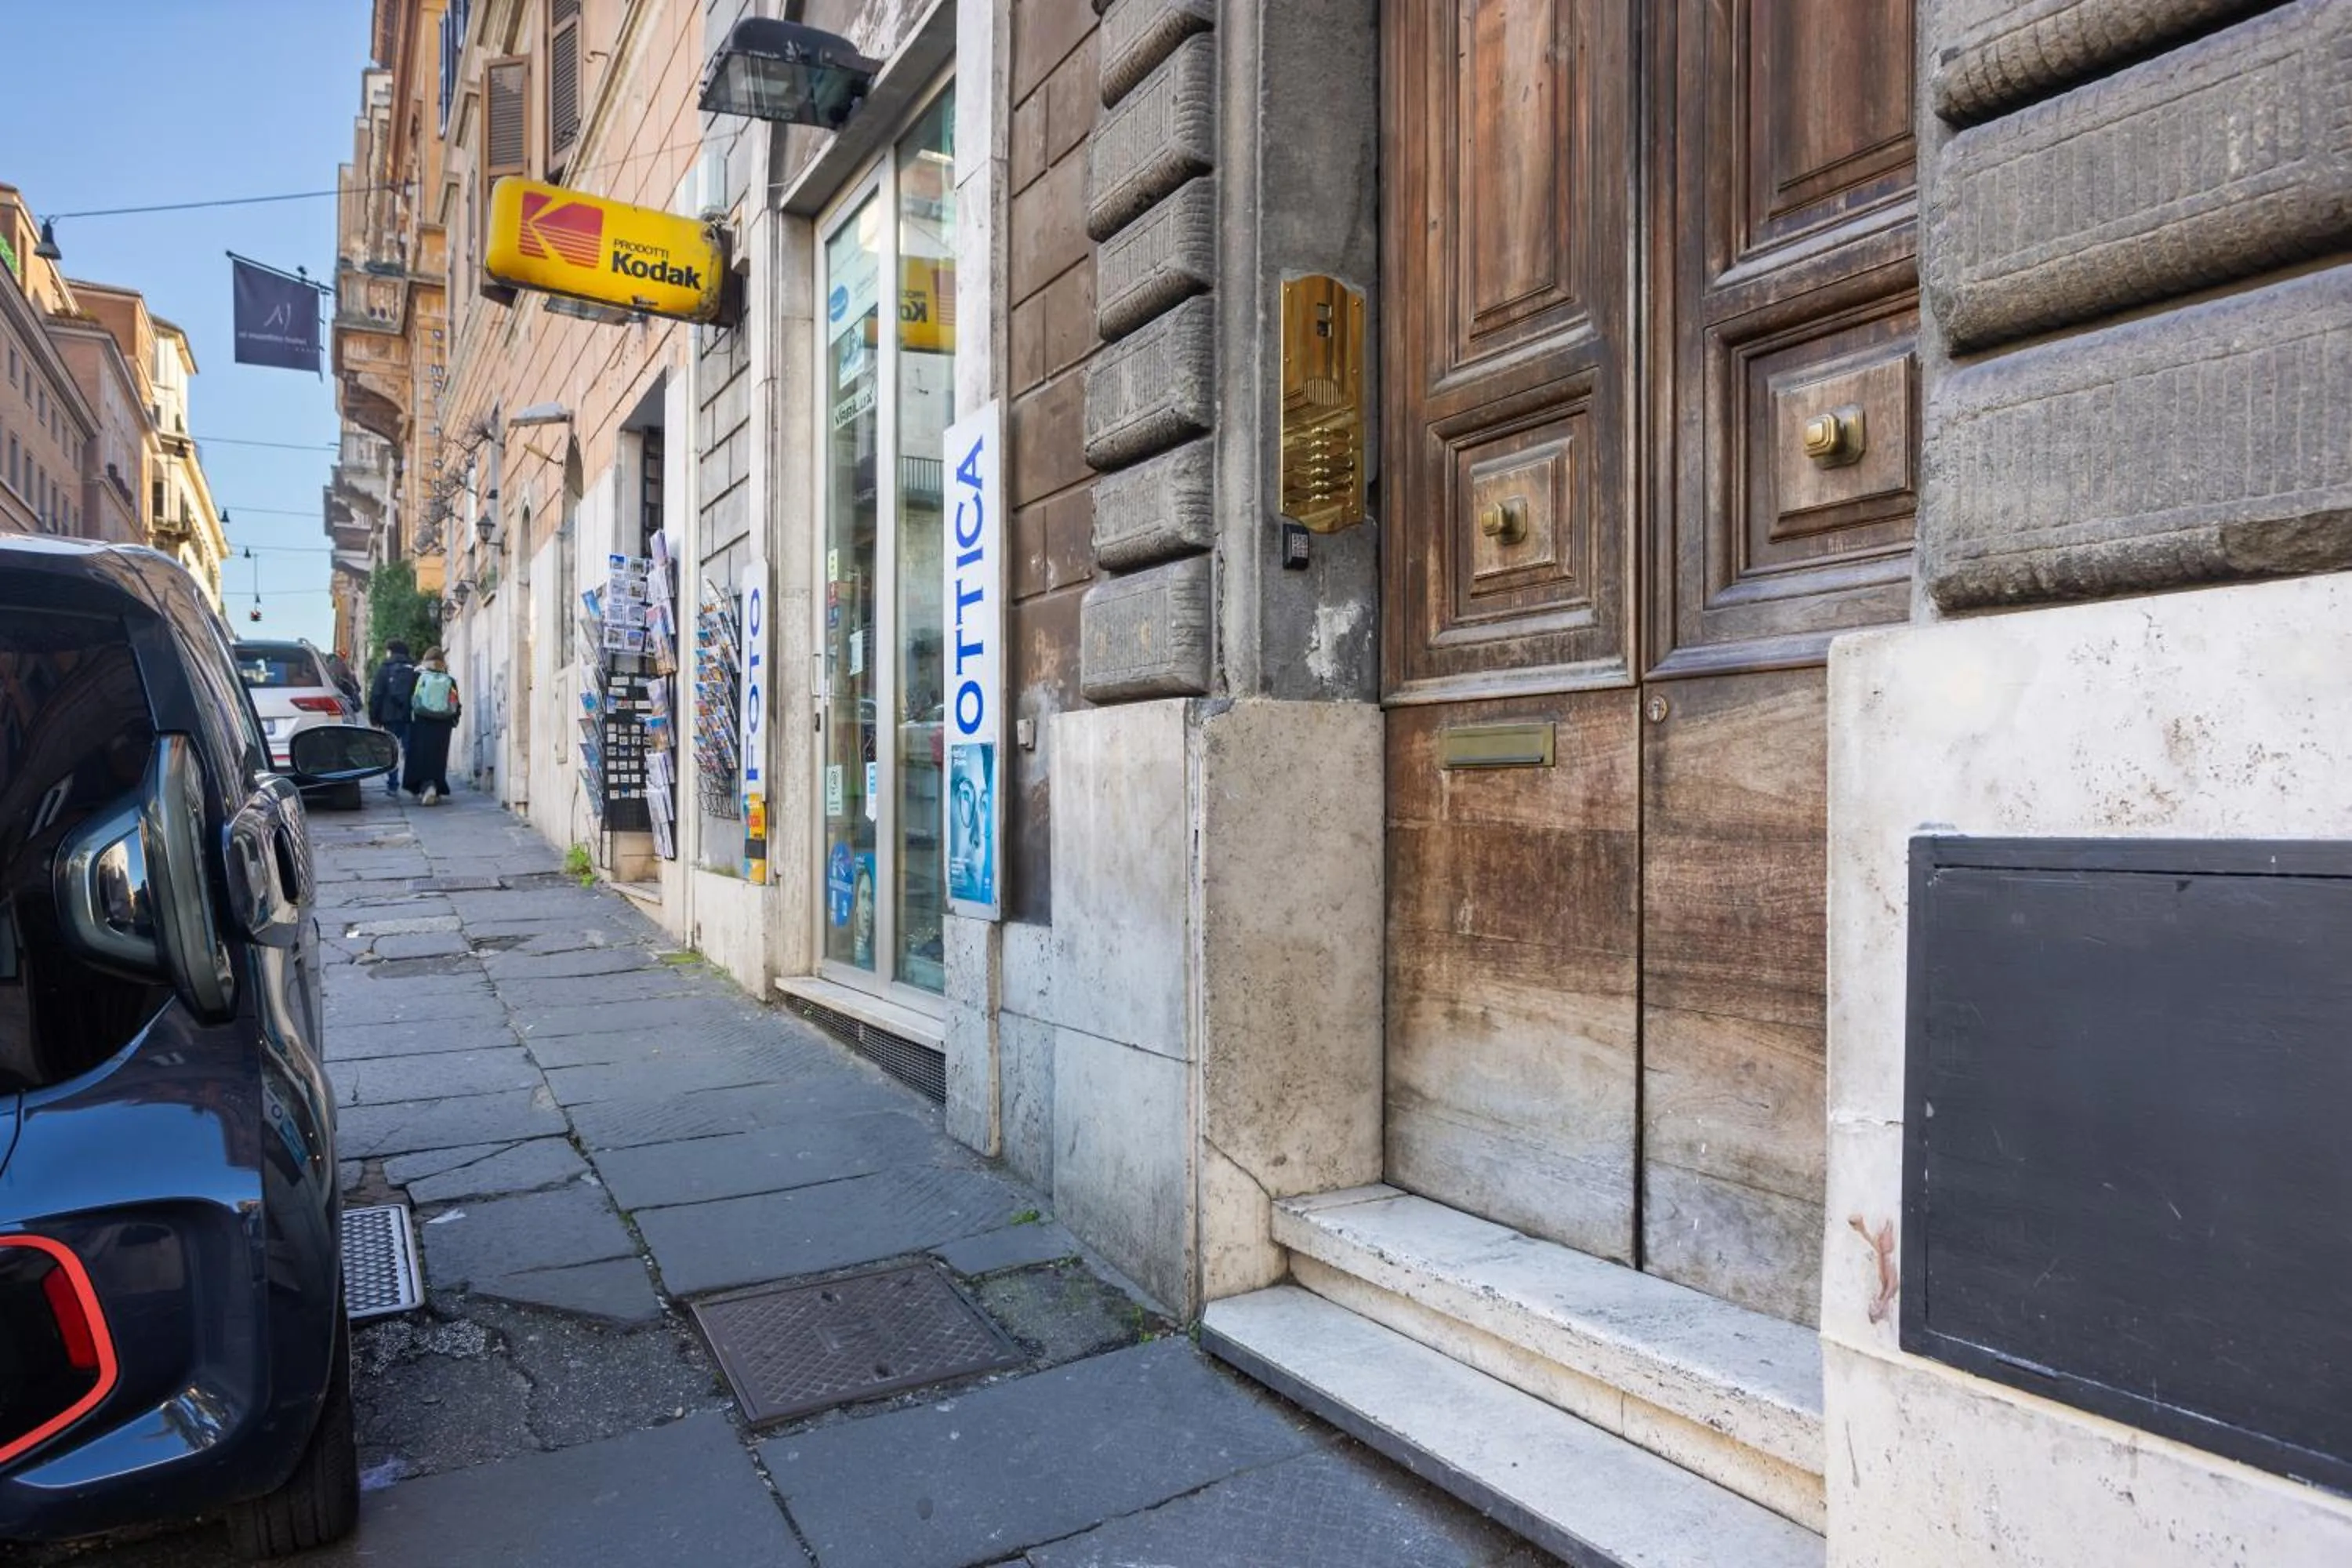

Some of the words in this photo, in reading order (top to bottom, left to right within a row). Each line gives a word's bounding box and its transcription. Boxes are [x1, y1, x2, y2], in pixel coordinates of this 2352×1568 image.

[612, 251, 702, 291] Kodak
[613, 238, 670, 258] PRODOTTI
[955, 434, 984, 735] OTTICA
[746, 588, 760, 782] FOTO
